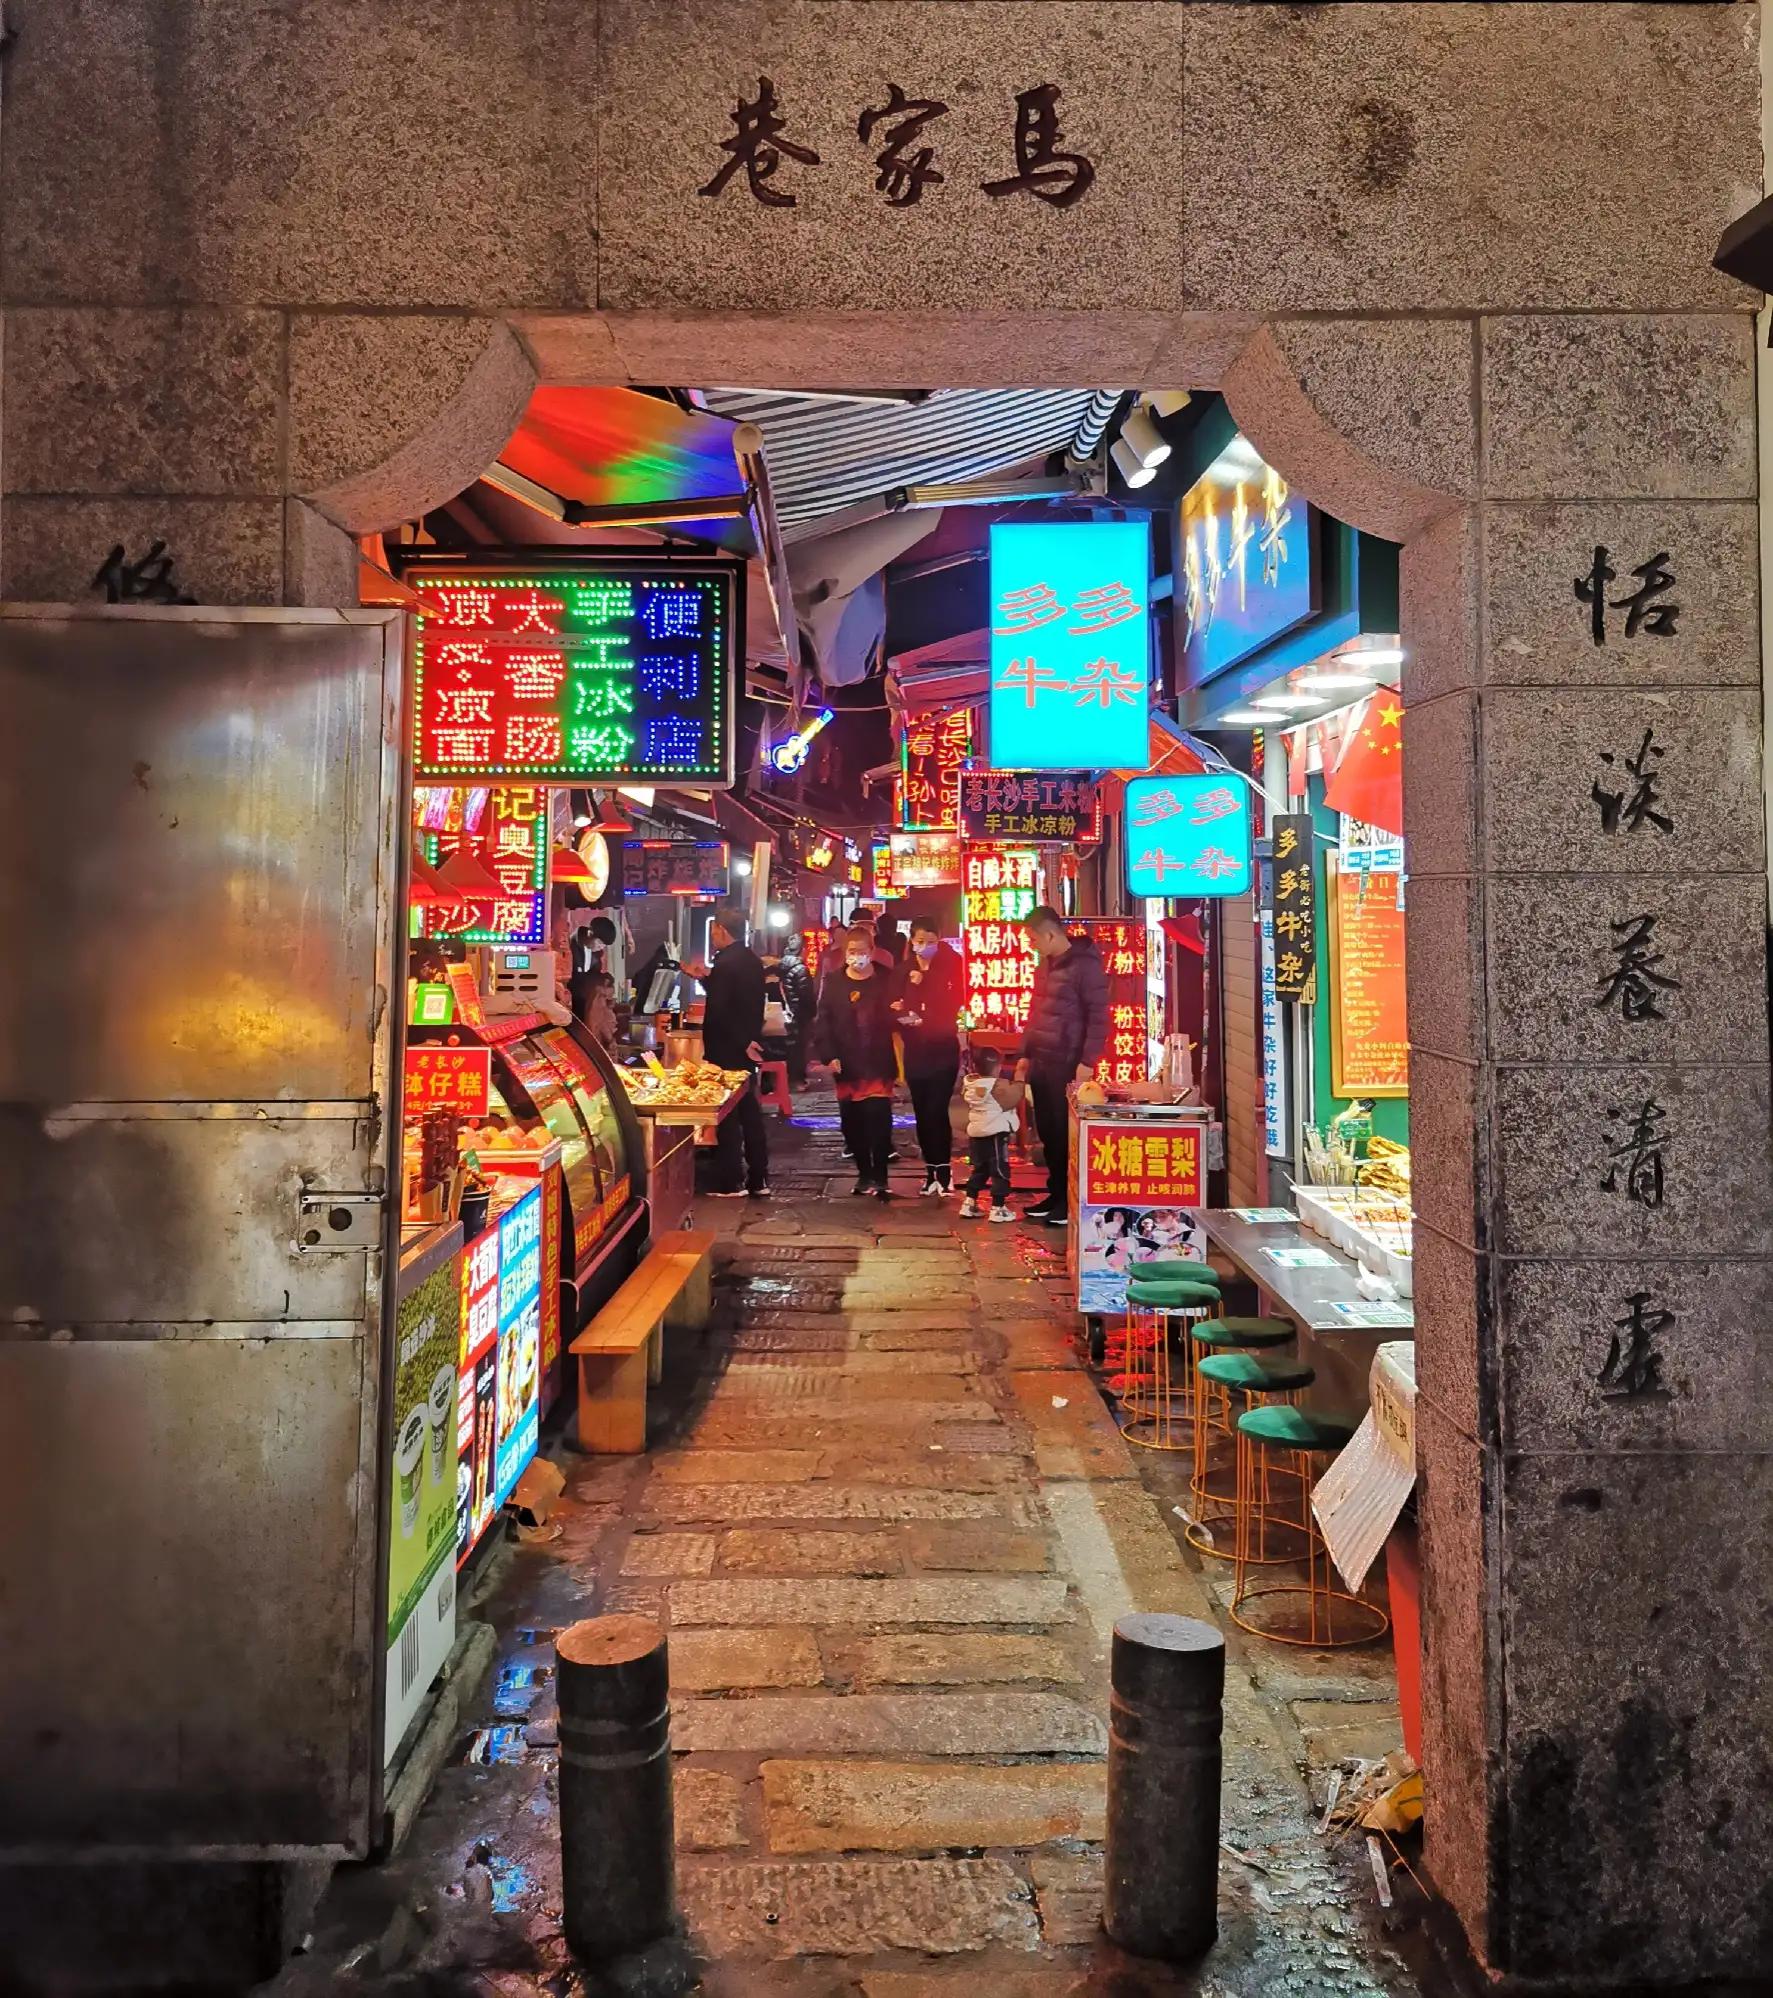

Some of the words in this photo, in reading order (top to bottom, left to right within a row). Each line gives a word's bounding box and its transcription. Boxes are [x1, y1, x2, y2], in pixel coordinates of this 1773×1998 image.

[993, 581, 1142, 636] 多多
[504, 592, 565, 762] 大香肠
[570, 589, 635, 765] 手工冰粉
[641, 591, 703, 765] 便利店
[994, 656, 1146, 709] 牛杂
[965, 777, 1097, 815] 老长沙手工米粉
[1131, 787, 1243, 827] 多多
[983, 813, 1078, 836] 手工冰凉粉
[967, 857, 1033, 889] 自酿米酒
[1131, 846, 1243, 882] 牛杂
[1275, 826, 1305, 984] 多多牛杂
[968, 956, 1036, 989] 欢迎进店
[1092, 1135, 1195, 1178] 冰糖雪梨
[1092, 1181, 1141, 1195] 生津养胃
[1146, 1182, 1196, 1196] 止咳润肺
